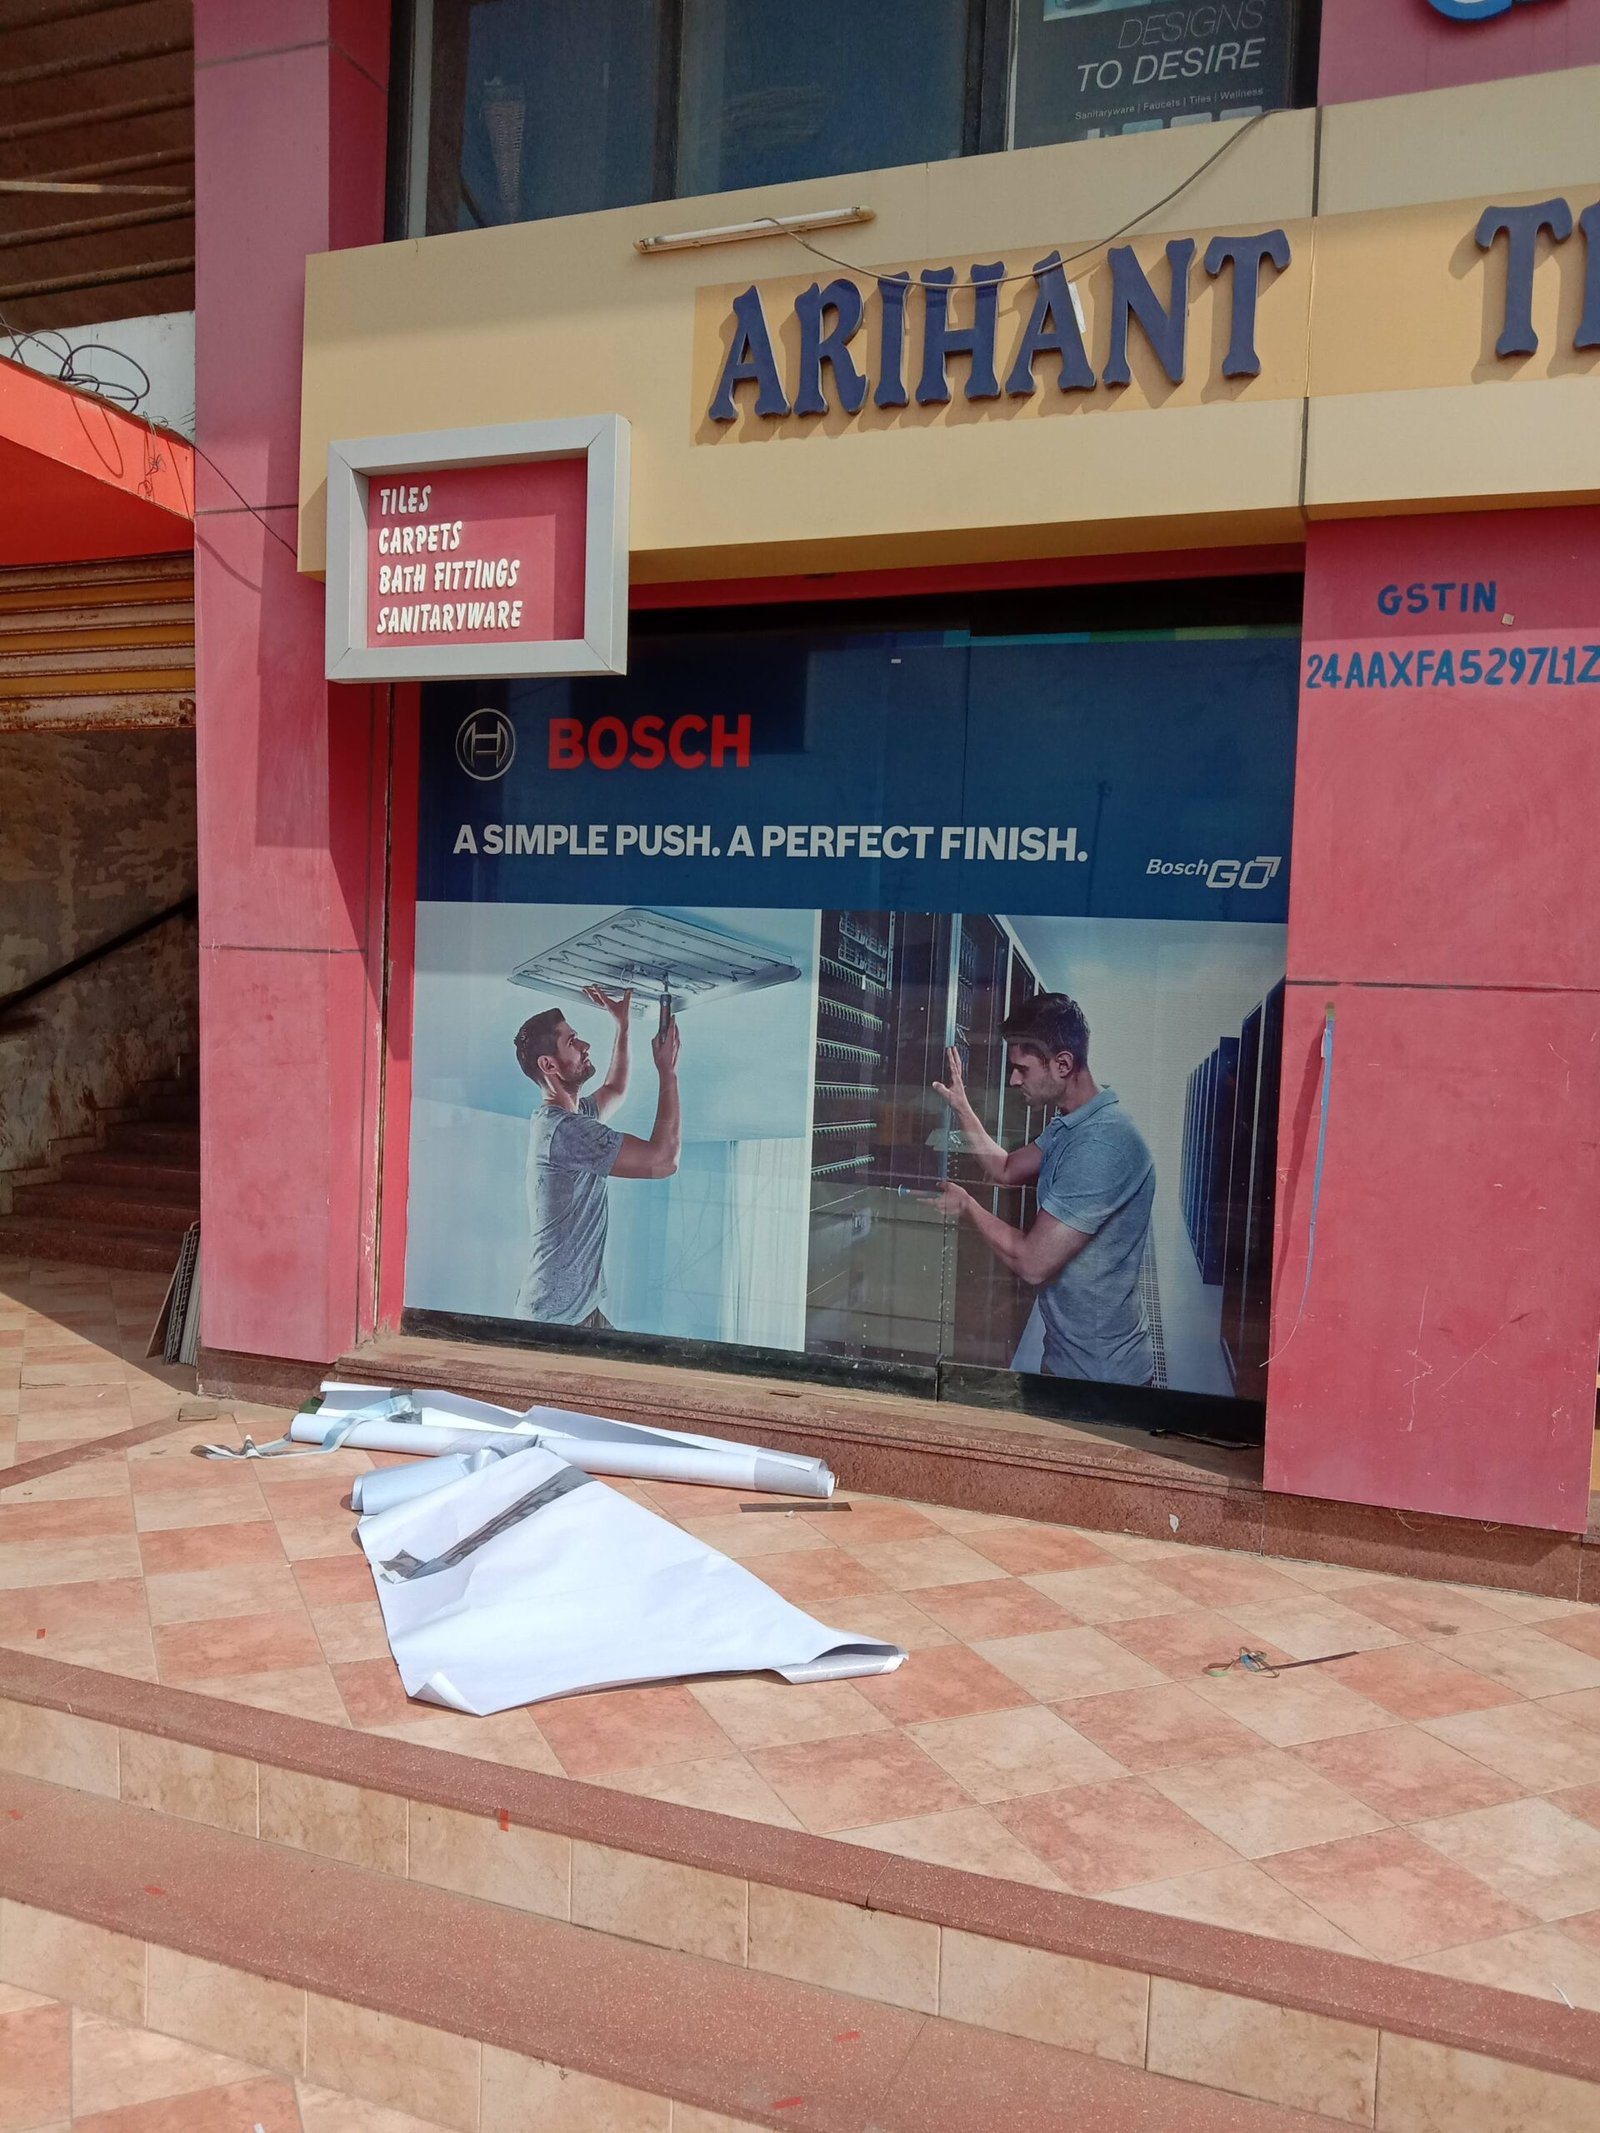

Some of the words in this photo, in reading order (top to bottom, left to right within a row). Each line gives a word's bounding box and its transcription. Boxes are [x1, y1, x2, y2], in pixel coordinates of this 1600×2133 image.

[1118, 1, 1265, 48] DESIGNS
[1078, 60, 1123, 92] TO
[1132, 37, 1266, 85] DESIRE
[1075, 105, 1135, 121] Sanitaryware
[1143, 100, 1180, 111] Faucets
[1189, 95, 1212, 105] Tiles
[1220, 88, 1264, 100] Wellness
[708, 228, 1292, 423] ARIHANT
[380, 485, 432, 515] TILES
[379, 521, 463, 554] CARPETS
[379, 564, 427, 594] BATH
[434, 558, 520, 591] FITTINGS
[1377, 580, 1497, 616] GSTIN
[376, 600, 523, 633] SANITARYWARE
[547, 714, 752, 770] BOSCH
[452, 824, 478, 855] A
[482, 824, 608, 856] SIMPLE
[615, 825, 720, 857] PUSH.
[726, 825, 755, 857] A
[761, 825, 934, 860] PERFECT
[940, 826, 1088, 862] FINISH.
